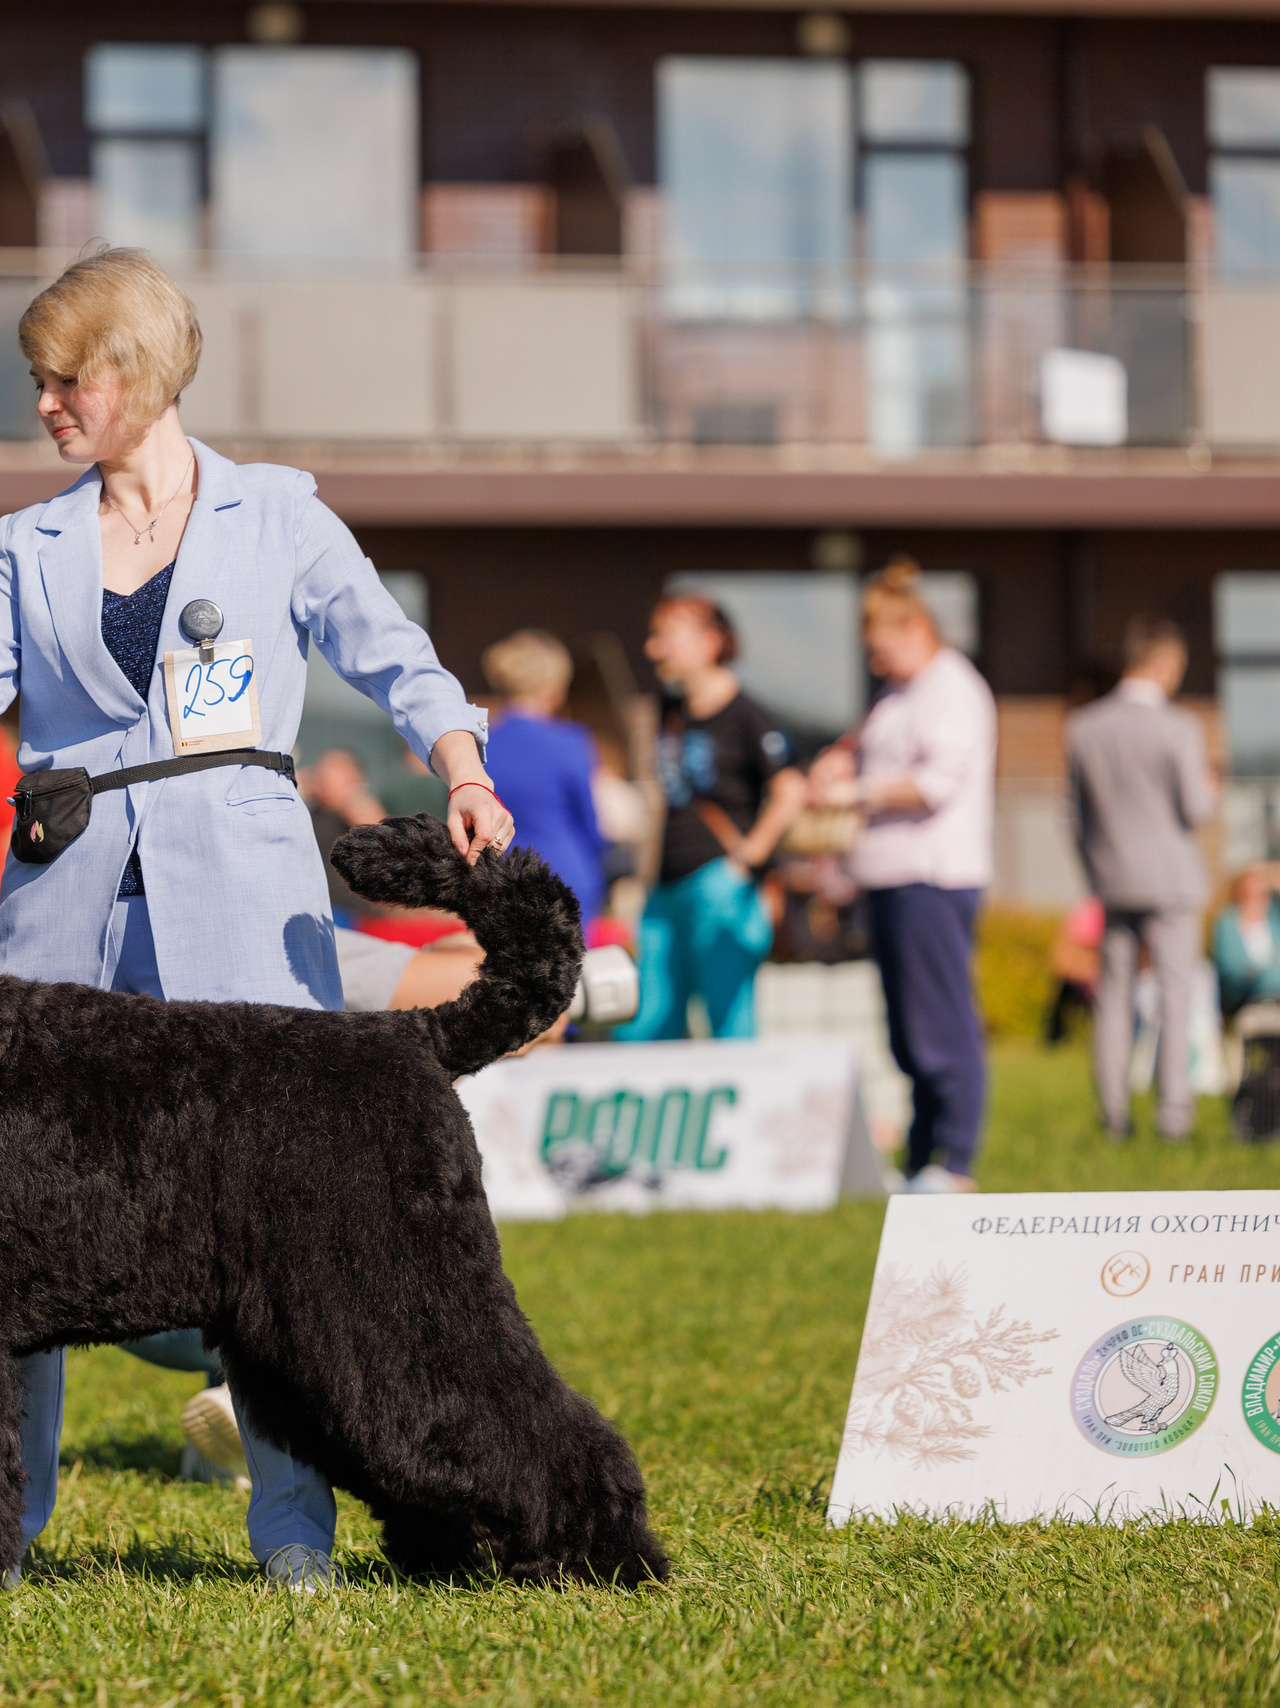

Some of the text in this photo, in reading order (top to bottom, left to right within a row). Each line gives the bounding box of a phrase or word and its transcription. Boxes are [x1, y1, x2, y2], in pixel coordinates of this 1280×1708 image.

[183, 654, 255, 719] 259
[971, 1215, 1143, 1237] ФЕДЕРАЦИЯ
[1169, 1264, 1280, 1283] ГРАН ПРИ
[1075, 1359, 1101, 1411] СУЗДАЛЬ
[1131, 1324, 1143, 1337] ОС
[1147, 1320, 1217, 1372] СУЗДАЛЬСКИЙ
[1192, 1373, 1216, 1412] СОКОЛ
[1245, 1346, 1277, 1418] ВЛАДИМИР
[1082, 1414, 1099, 1434] ГРАН
[1096, 1432, 1112, 1445] ПРИ
[1254, 1419, 1272, 1438] ГРАН
